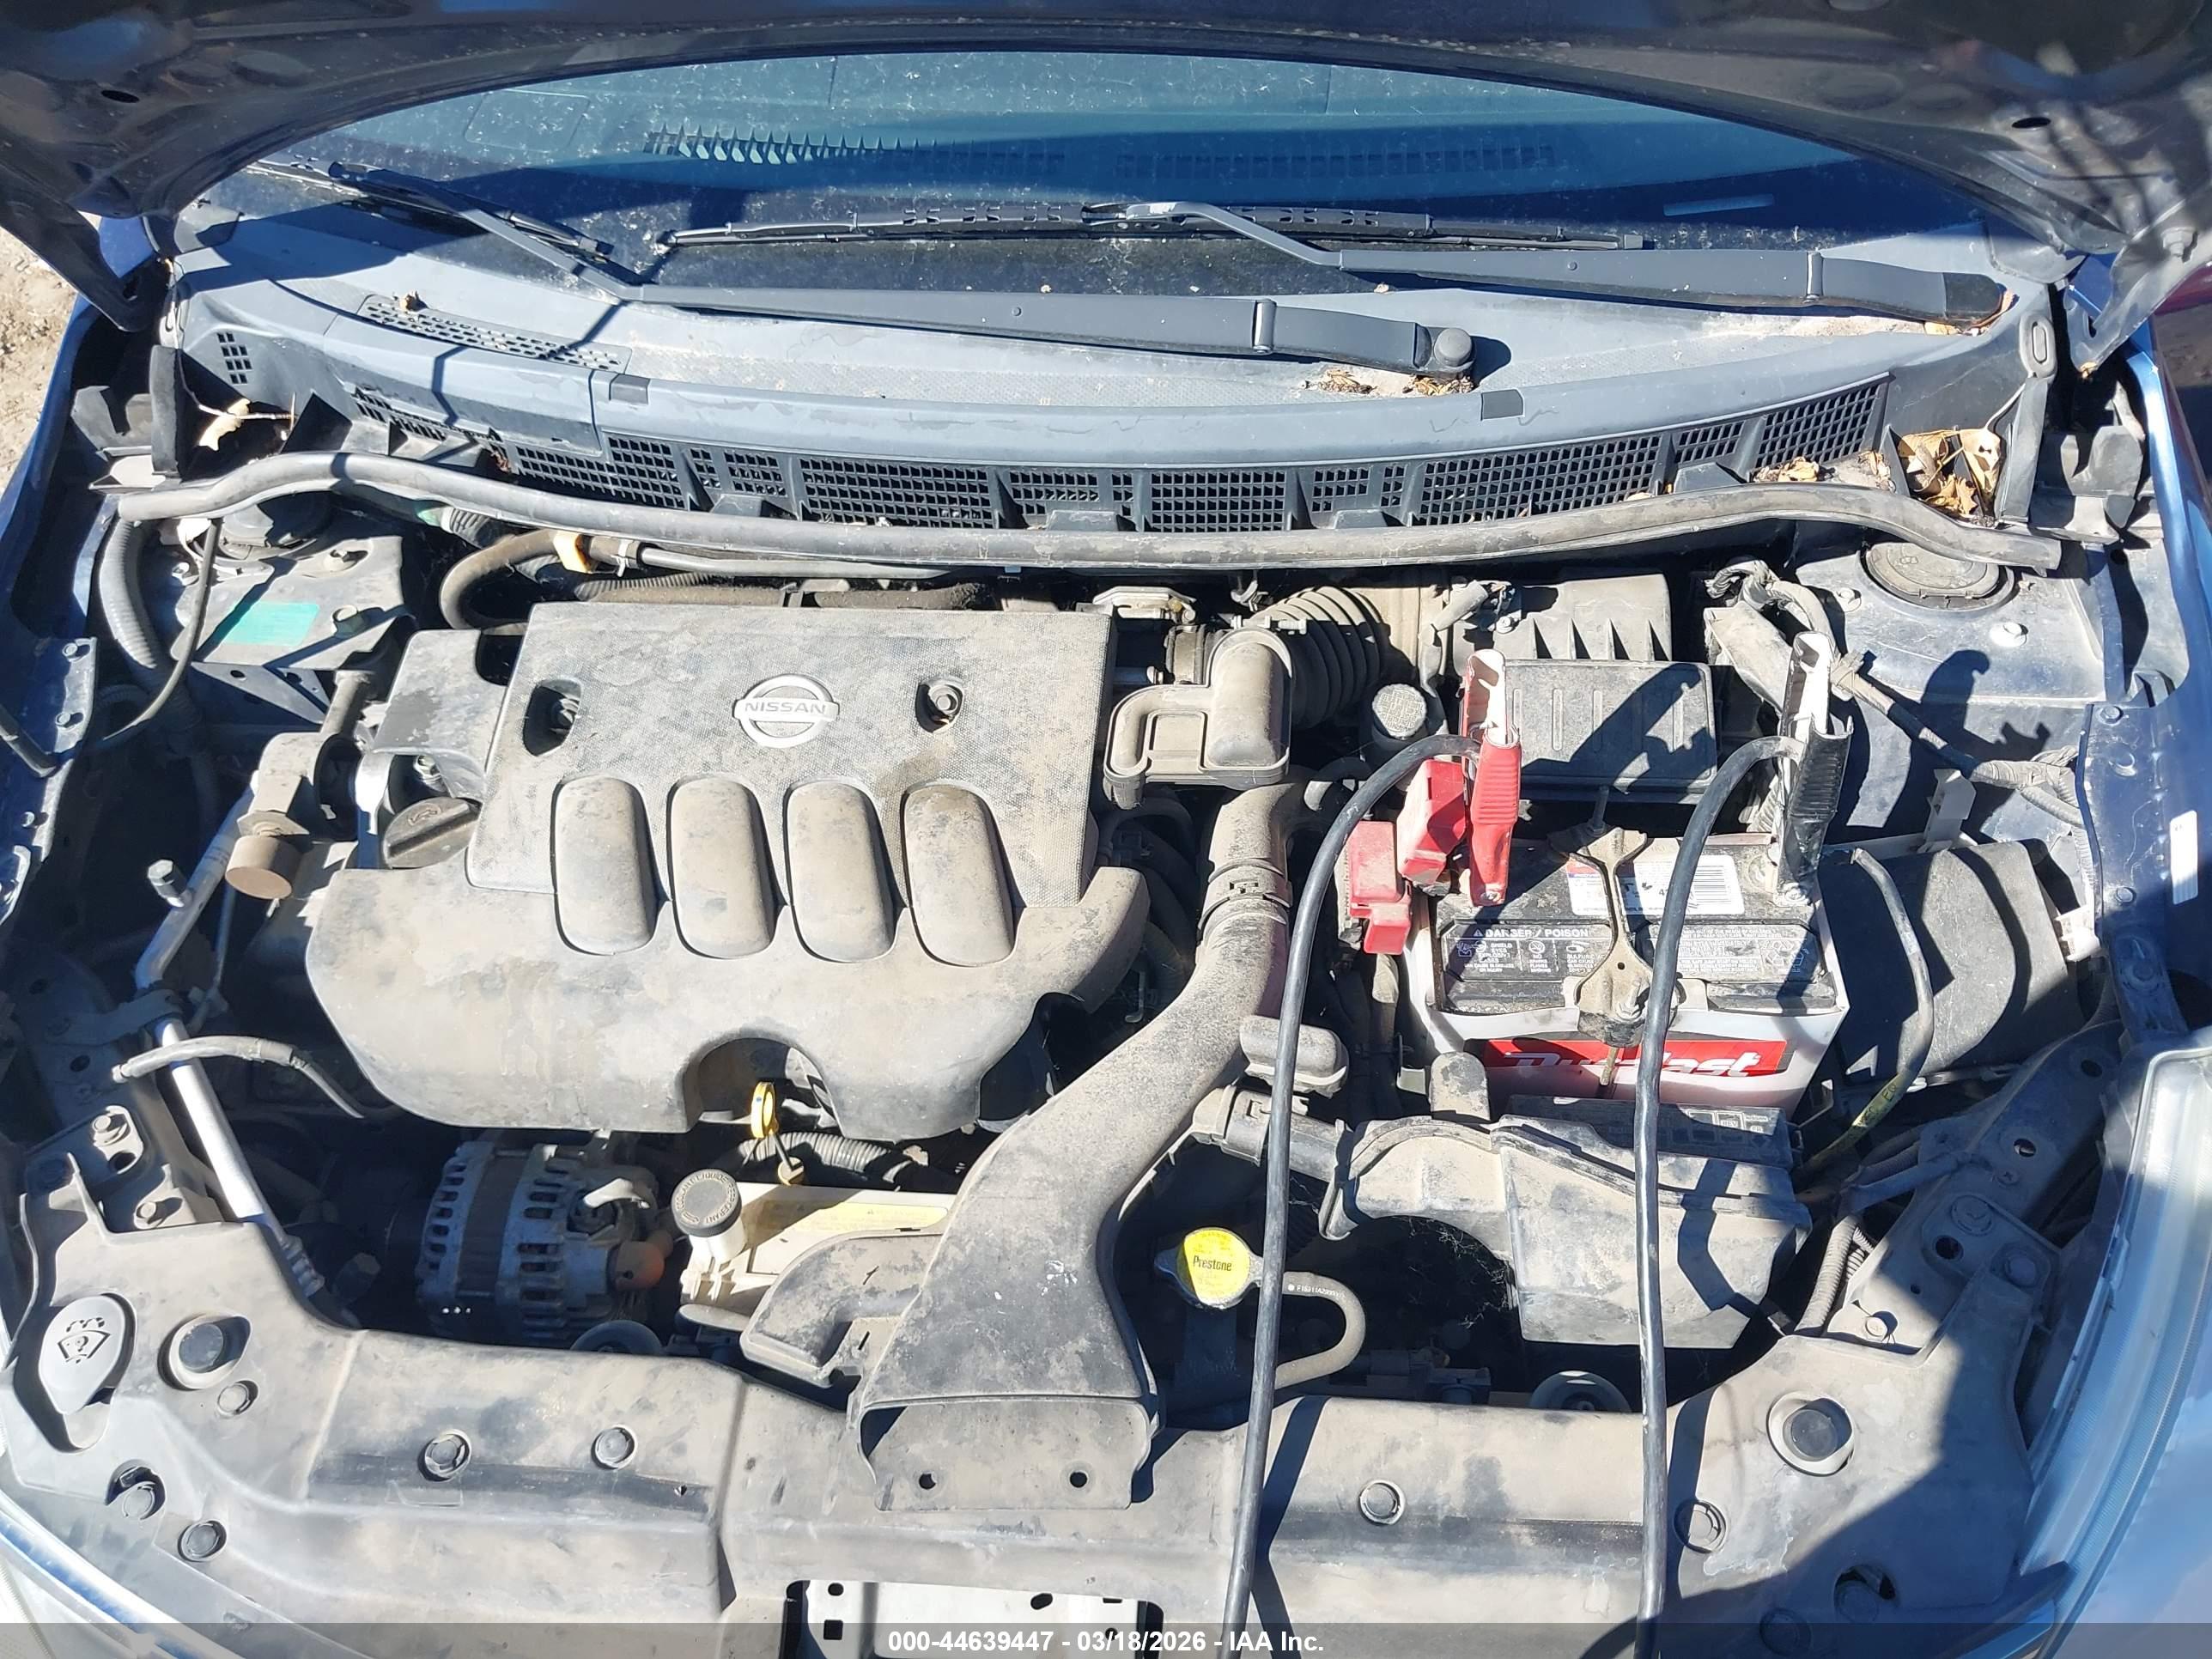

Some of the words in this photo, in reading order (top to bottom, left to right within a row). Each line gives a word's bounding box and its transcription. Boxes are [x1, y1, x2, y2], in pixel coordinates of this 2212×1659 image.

[744, 702, 826, 714] NISSAN
[1545, 929, 1588, 938] POISON
[1194, 1255, 1232, 1271] Prestone
